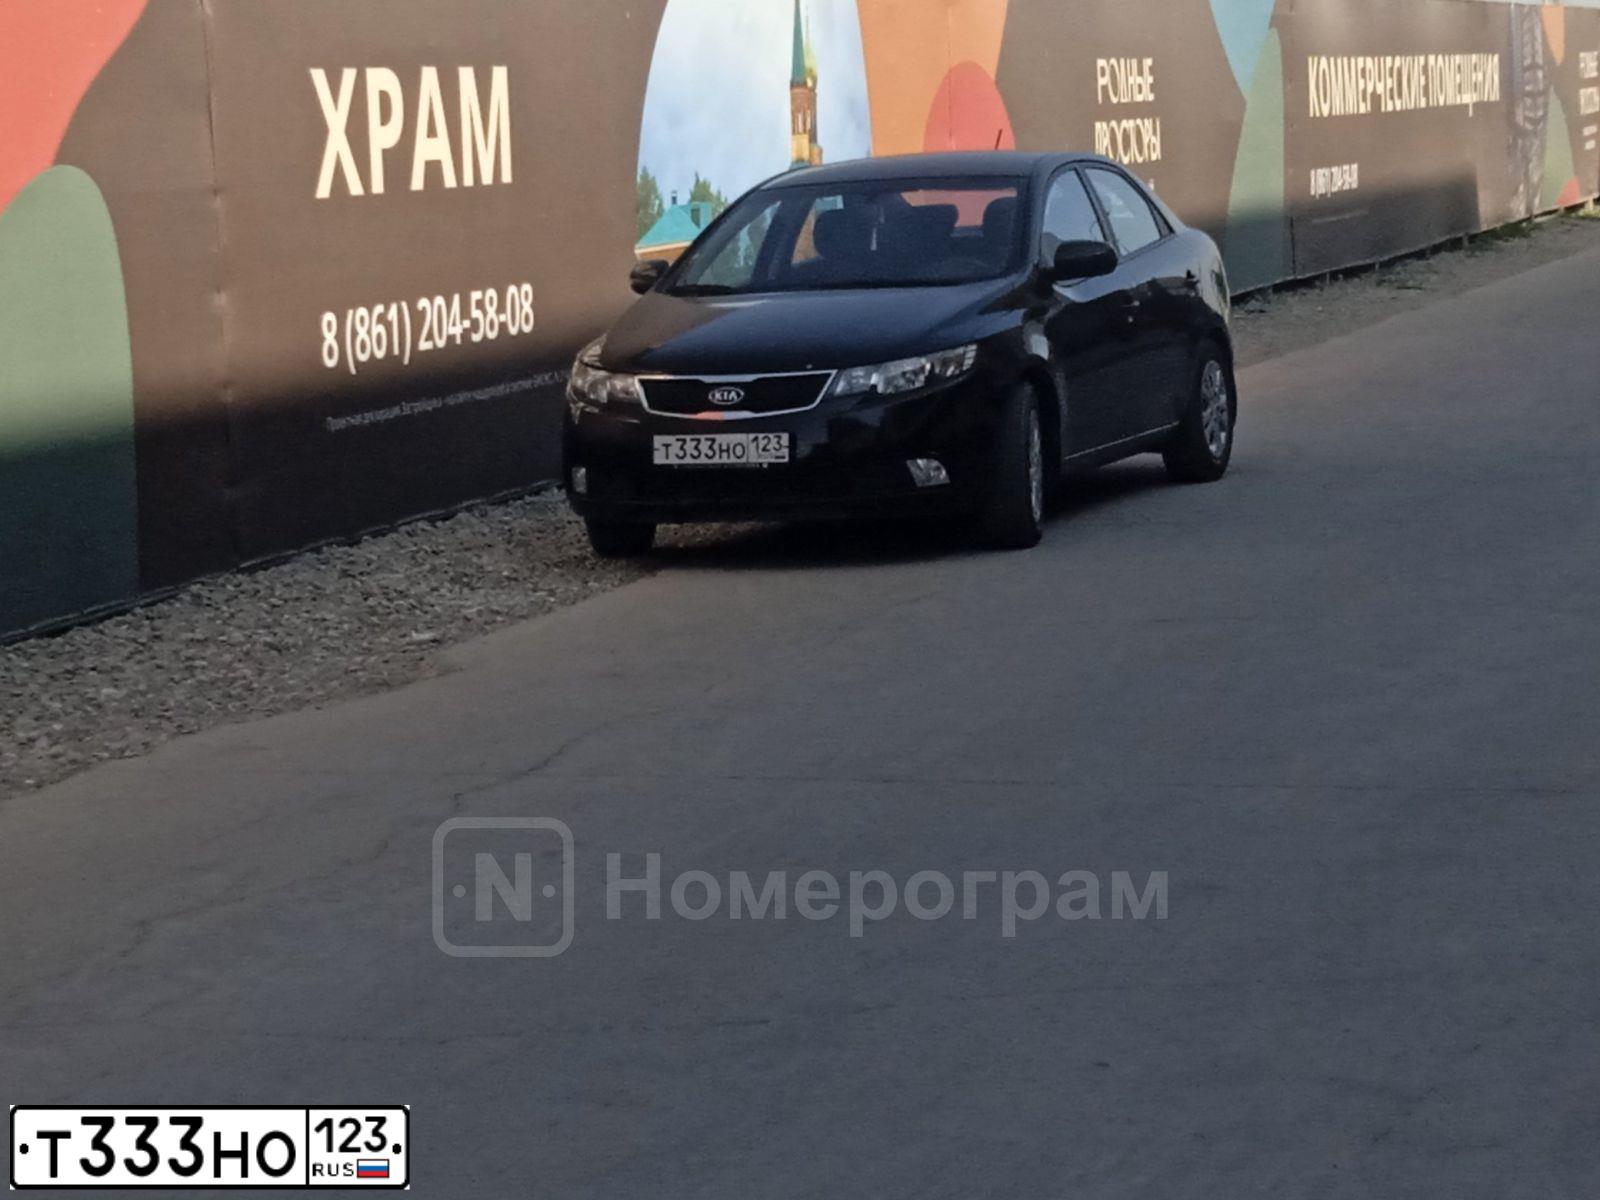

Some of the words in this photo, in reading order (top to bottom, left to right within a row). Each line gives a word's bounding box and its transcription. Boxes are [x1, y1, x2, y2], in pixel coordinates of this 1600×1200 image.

[1096, 57, 1155, 104] РОДНЫЕ
[1308, 55, 1427, 117] КОММЕРЧЕСКИЕ
[1428, 53, 1500, 117] ПОМЕЩЕНИЯ
[309, 65, 513, 199] ХРАМ
[1094, 117, 1162, 165] ПРОСТОРЫ
[321, 311, 340, 368] 8
[345, 300, 412, 375] (861)
[417, 282, 535, 351] 204-58-08
[713, 390, 739, 401] KIA
[661, 437, 746, 460] Т333НО
[750, 434, 783, 453] 123
